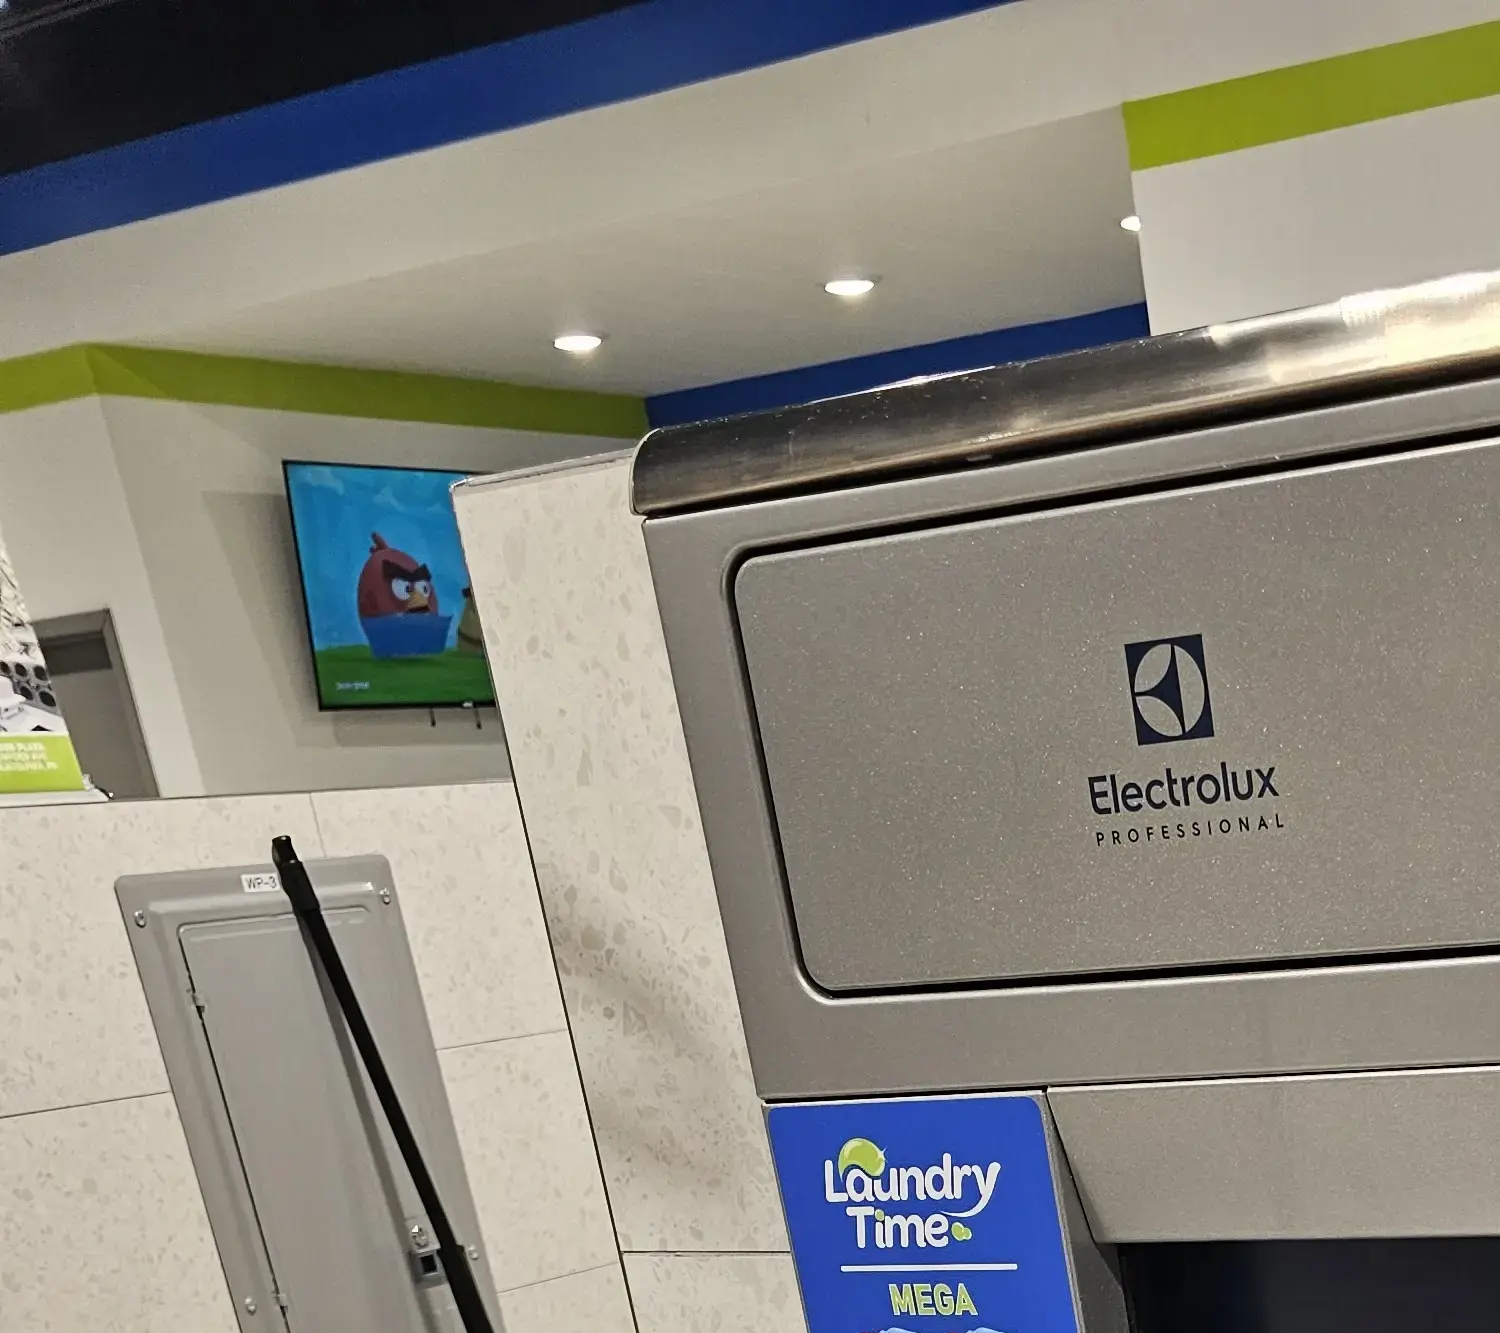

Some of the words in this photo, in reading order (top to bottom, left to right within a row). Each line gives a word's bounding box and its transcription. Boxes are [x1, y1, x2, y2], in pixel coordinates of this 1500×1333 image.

[1088, 761, 1280, 815] Electrolux
[1096, 813, 1284, 846] PROFESSIONAL
[245, 875, 277, 890] WP-3
[824, 1152, 1001, 1218] Laundry
[845, 1205, 949, 1249] Time
[888, 1282, 978, 1316] MEGA
